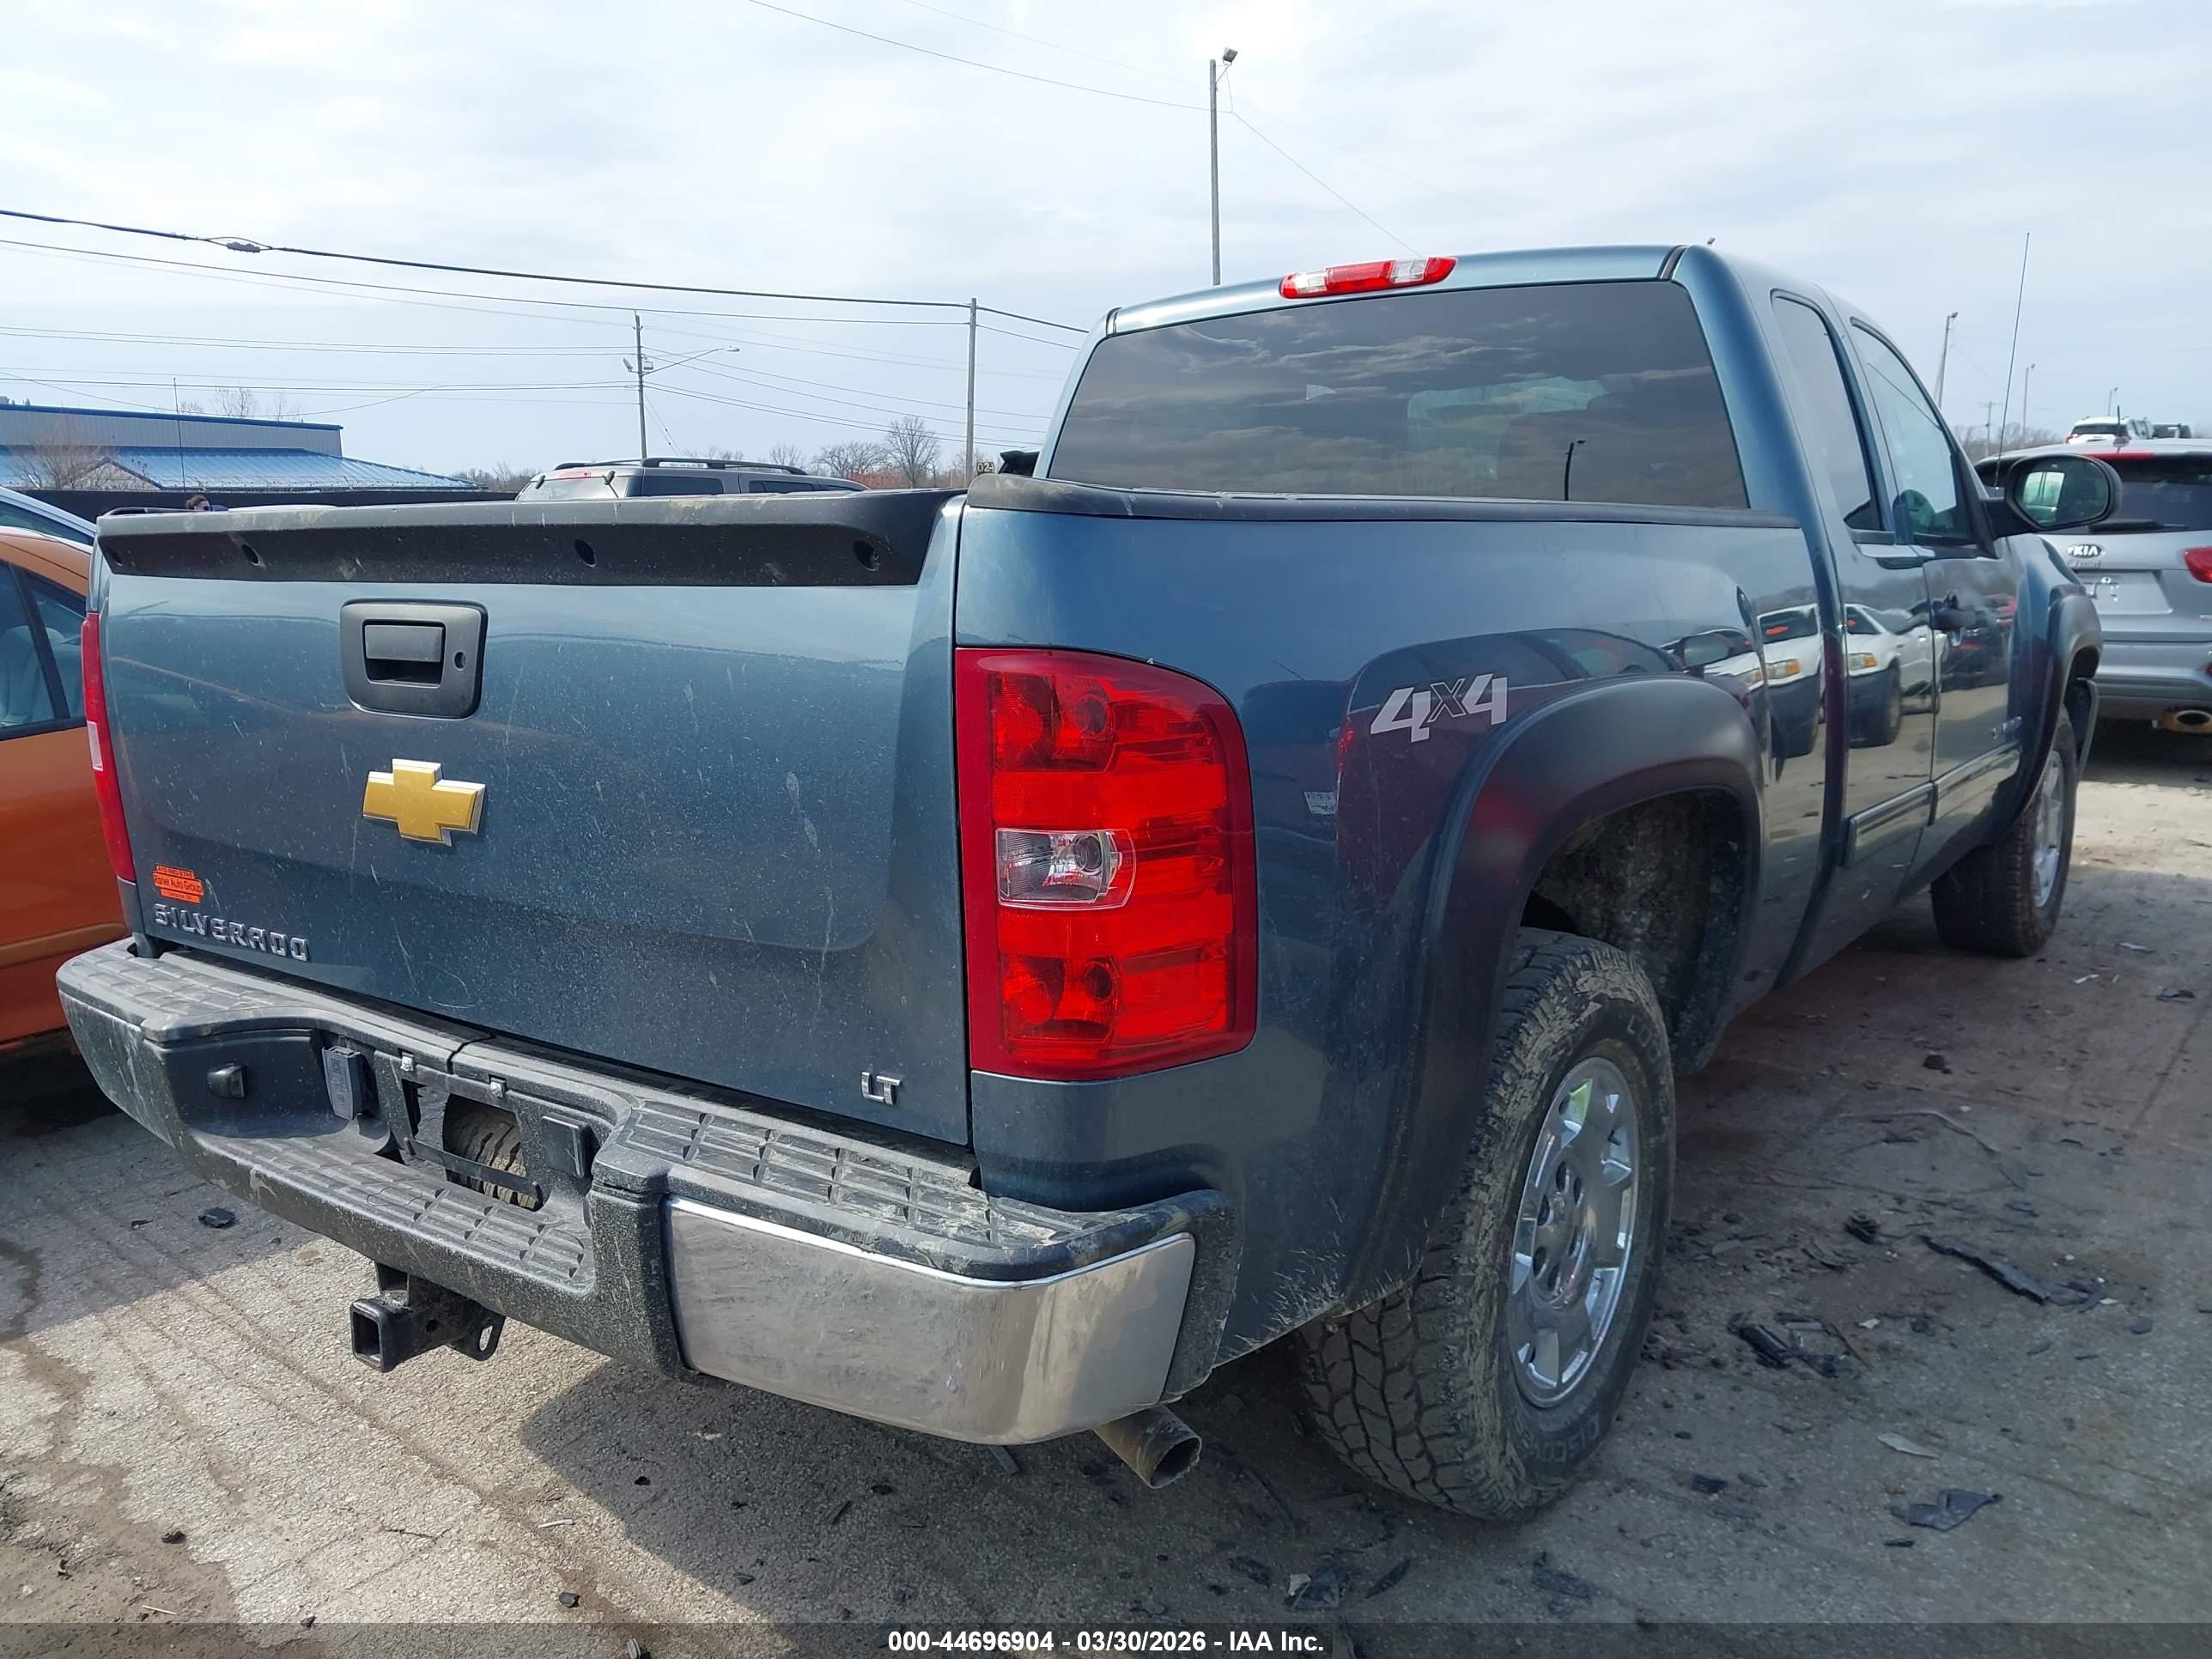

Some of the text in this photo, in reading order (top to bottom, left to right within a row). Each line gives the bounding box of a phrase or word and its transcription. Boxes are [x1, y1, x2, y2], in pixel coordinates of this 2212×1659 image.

[2072, 545, 2099, 556] KIA
[154, 903, 309, 962] SILVERADO
[861, 1072, 901, 1105] LT
